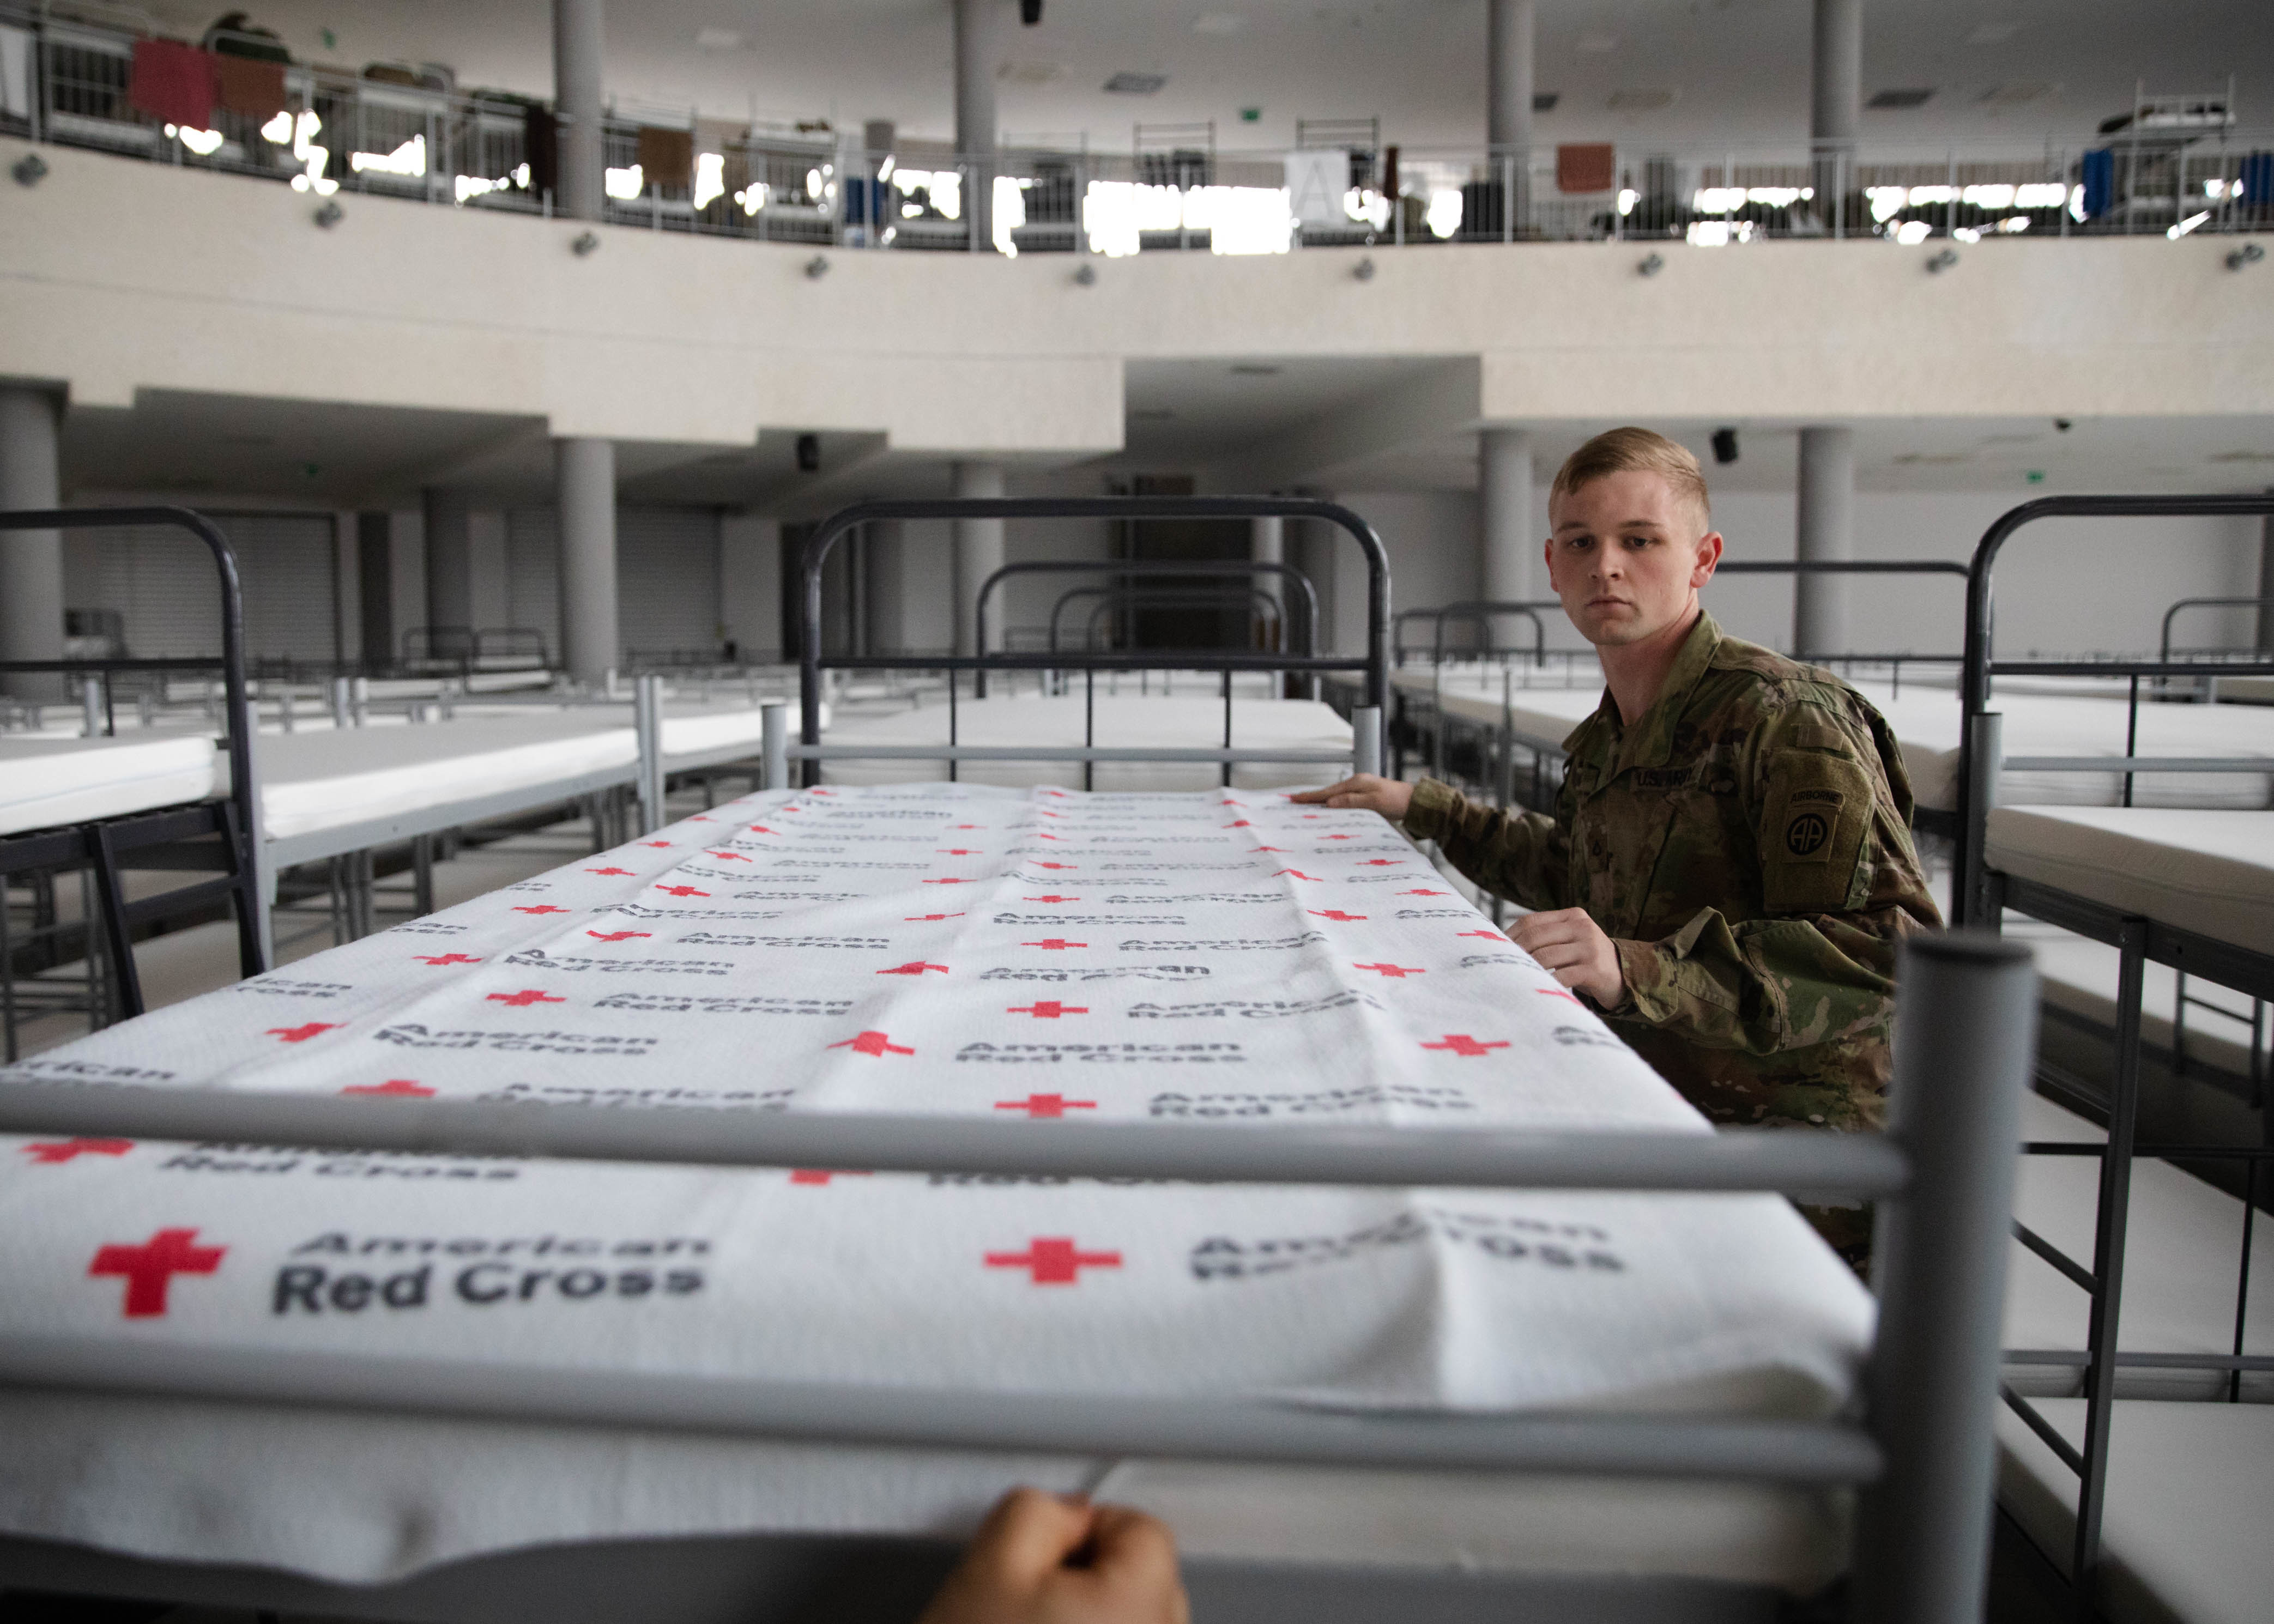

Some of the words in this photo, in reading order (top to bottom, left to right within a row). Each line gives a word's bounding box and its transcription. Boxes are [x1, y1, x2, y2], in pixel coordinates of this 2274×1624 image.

[1789, 790, 1841, 804] AIRBORNE
[1790, 816, 1825, 852] AA
[676, 938, 756, 946] Red
[765, 941, 888, 949] Cross
[682, 932, 890, 942] American
[1121, 931, 1325, 946] American
[504, 955, 591, 971] Red
[599, 965, 728, 975] Cross
[518, 949, 735, 968] American
[979, 973, 1067, 981] Red
[592, 999, 693, 1012] Red
[703, 1004, 849, 1016] Cross
[605, 992, 853, 1007] American
[1127, 1008, 1226, 1019] Red
[373, 1029, 480, 1049] Red
[489, 1040, 647, 1056] Cross
[389, 1023, 658, 1046] American
[959, 1042, 1241, 1052] American
[955, 1053, 1062, 1063] Red
[1079, 1053, 1248, 1063] Cross
[1152, 1083, 1464, 1103] American
[1148, 1102, 1271, 1117] Red
[161, 1154, 299, 1175] Red
[312, 1158, 518, 1180] Cross
[289, 1229, 710, 1257] American
[270, 1261, 433, 1317] Red
[452, 1261, 705, 1306] Cross
